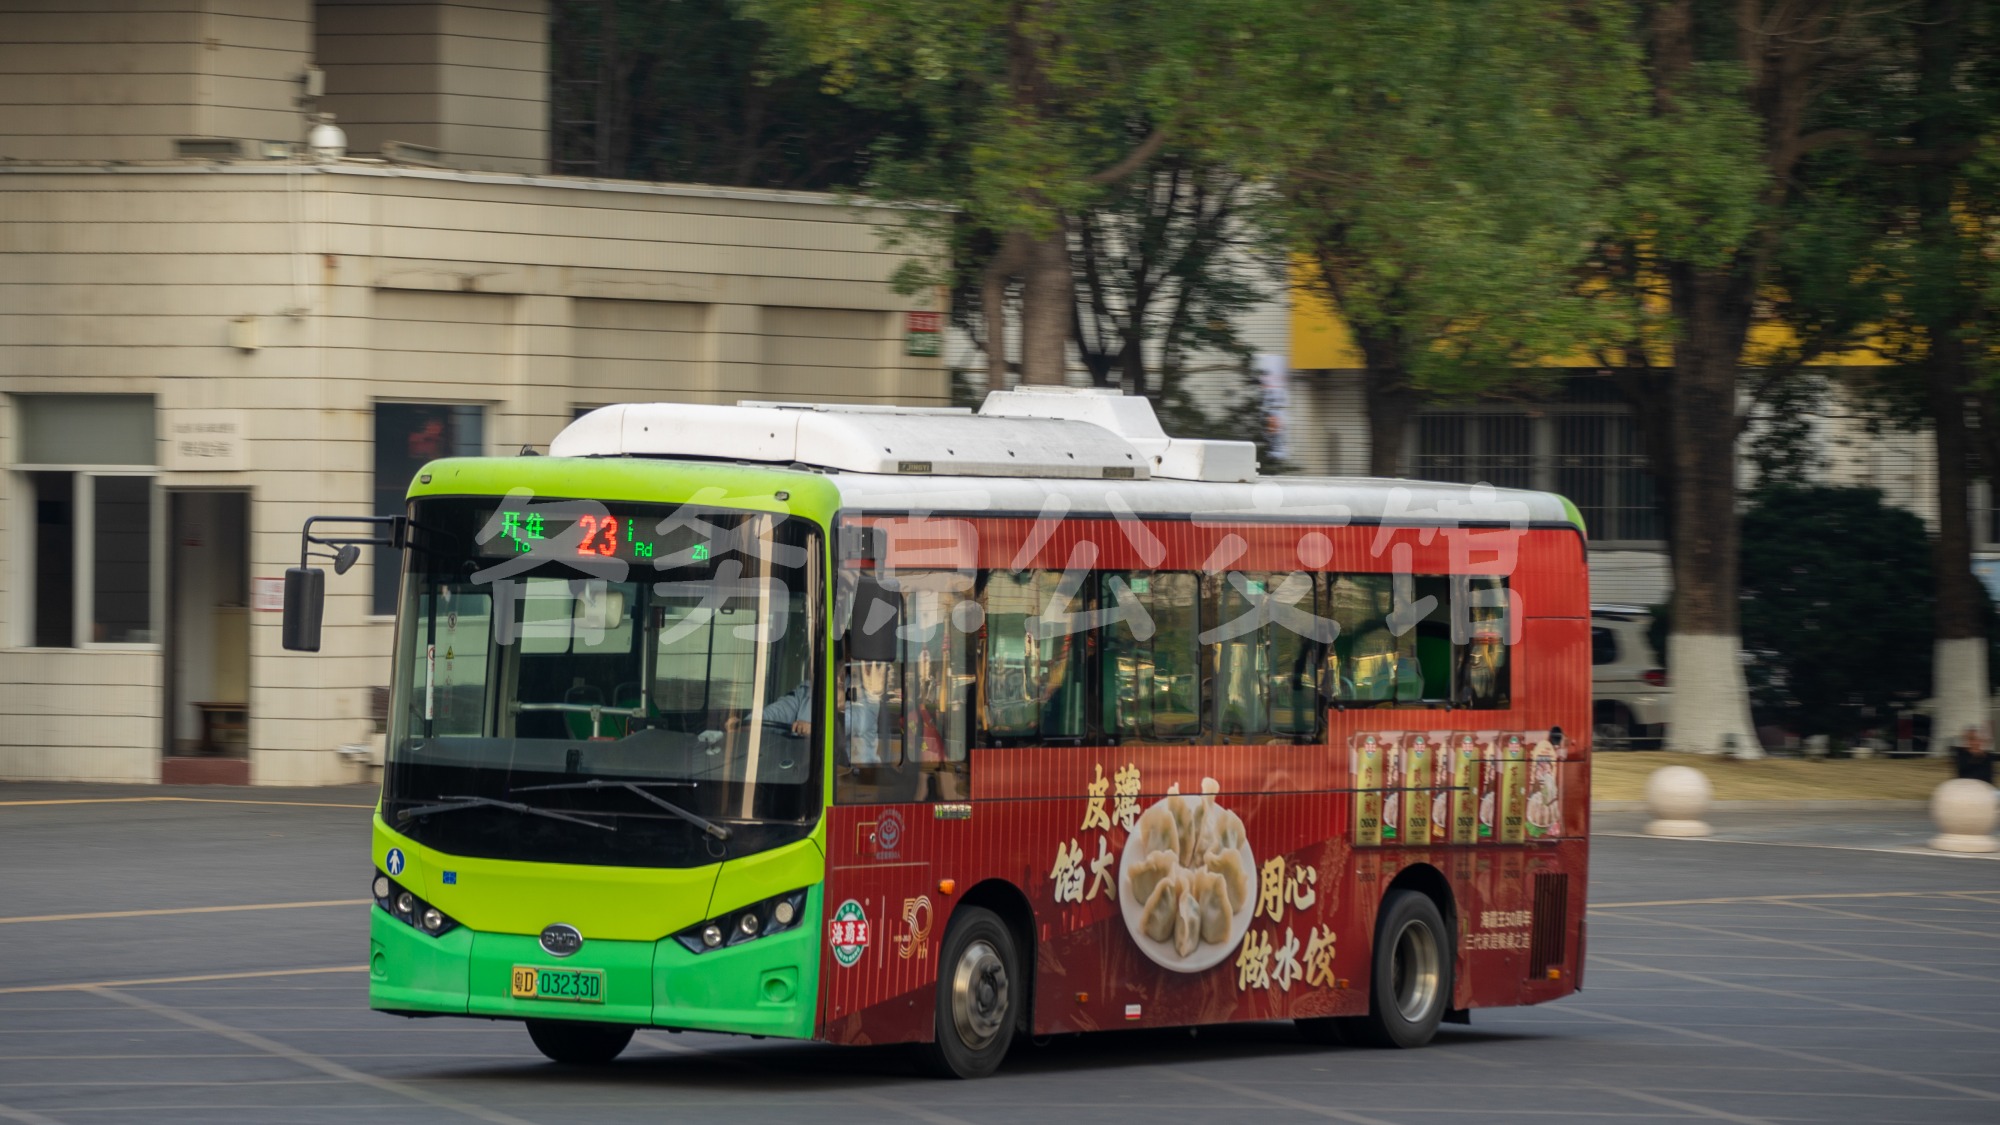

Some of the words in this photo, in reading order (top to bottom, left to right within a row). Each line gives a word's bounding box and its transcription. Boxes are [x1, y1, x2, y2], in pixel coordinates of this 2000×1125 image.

[501, 511, 545, 539] 开往
[578, 515, 618, 556] 23
[514, 538, 531, 552] To
[634, 541, 653, 557] Rd
[691, 544, 709, 560] Zh
[1081, 763, 1141, 833] 皮薄
[1050, 835, 1117, 903] 馅大
[1254, 855, 1317, 923] 用心
[1236, 923, 1337, 991] 做水饺
